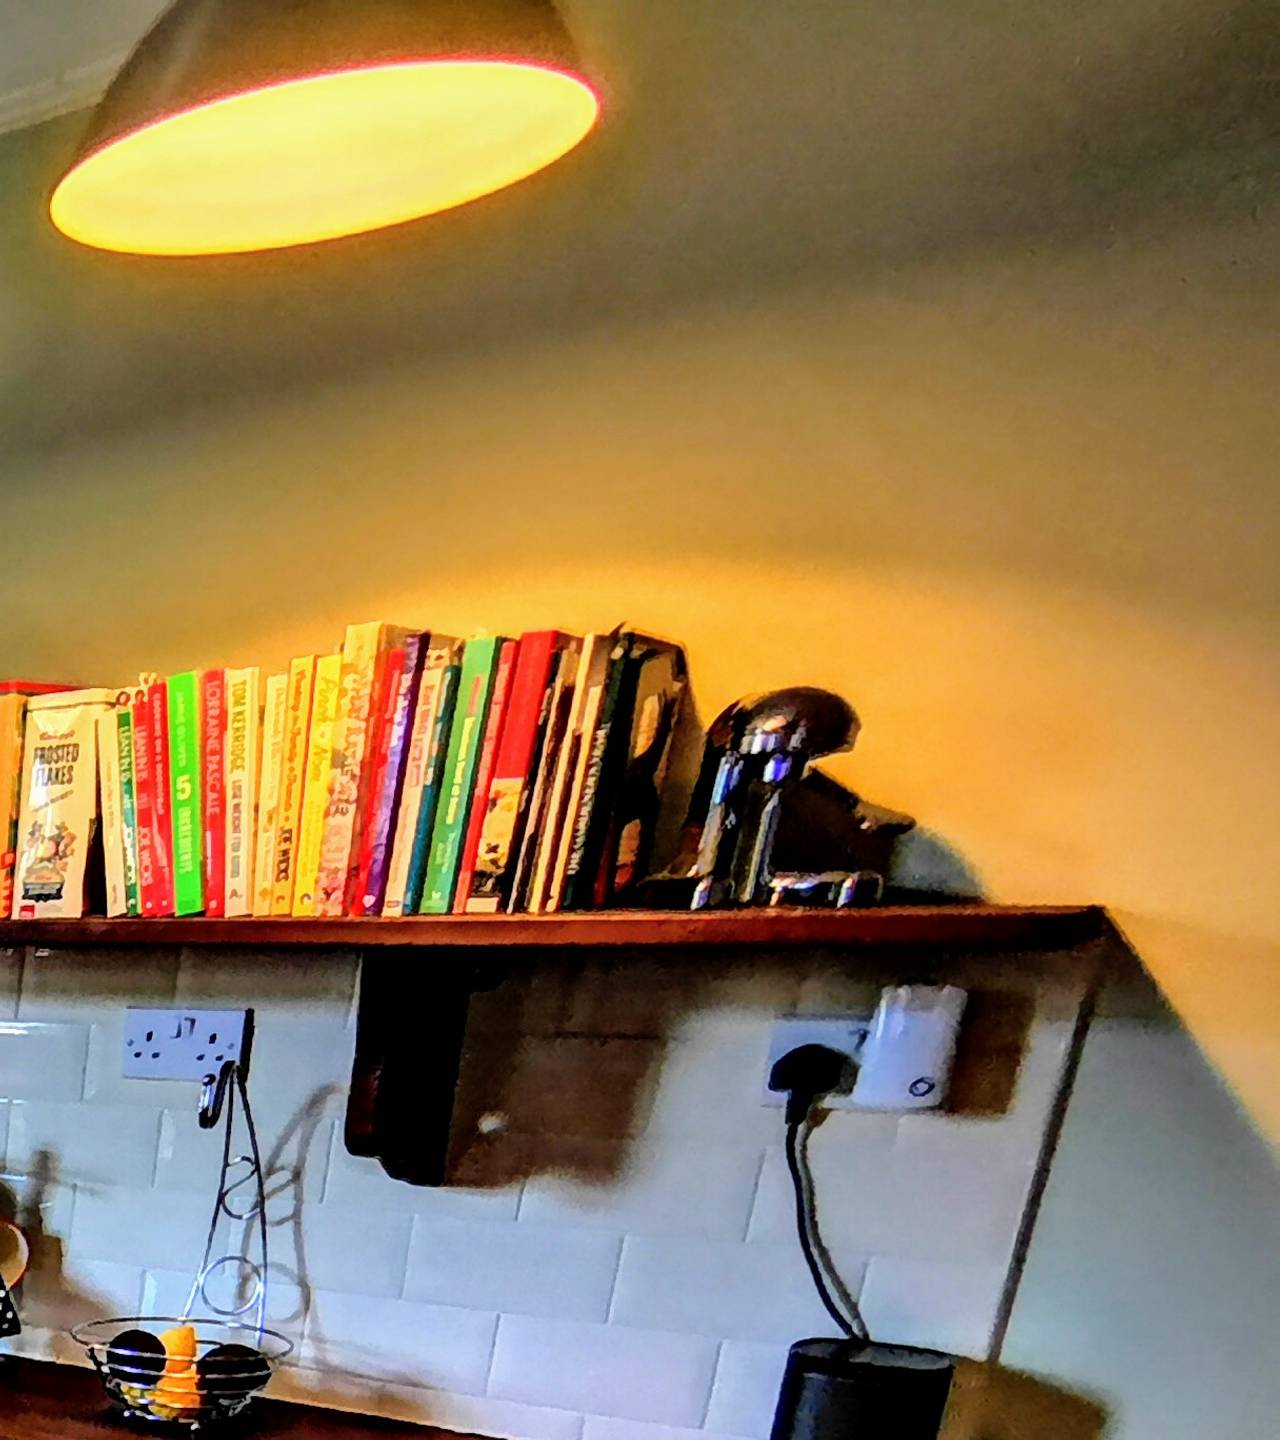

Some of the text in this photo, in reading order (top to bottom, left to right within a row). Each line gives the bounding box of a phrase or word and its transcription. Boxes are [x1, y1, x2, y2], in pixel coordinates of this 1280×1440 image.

[231, 680, 247, 708] TOM
[205, 680, 222, 752] LORRAINE
[33, 743, 80, 765] FROSTED
[229, 708, 247, 775] KERRIDGE
[35, 764, 74, 788] FLAKES
[176, 773, 192, 801] 5
[205, 753, 222, 817] PASCALE
